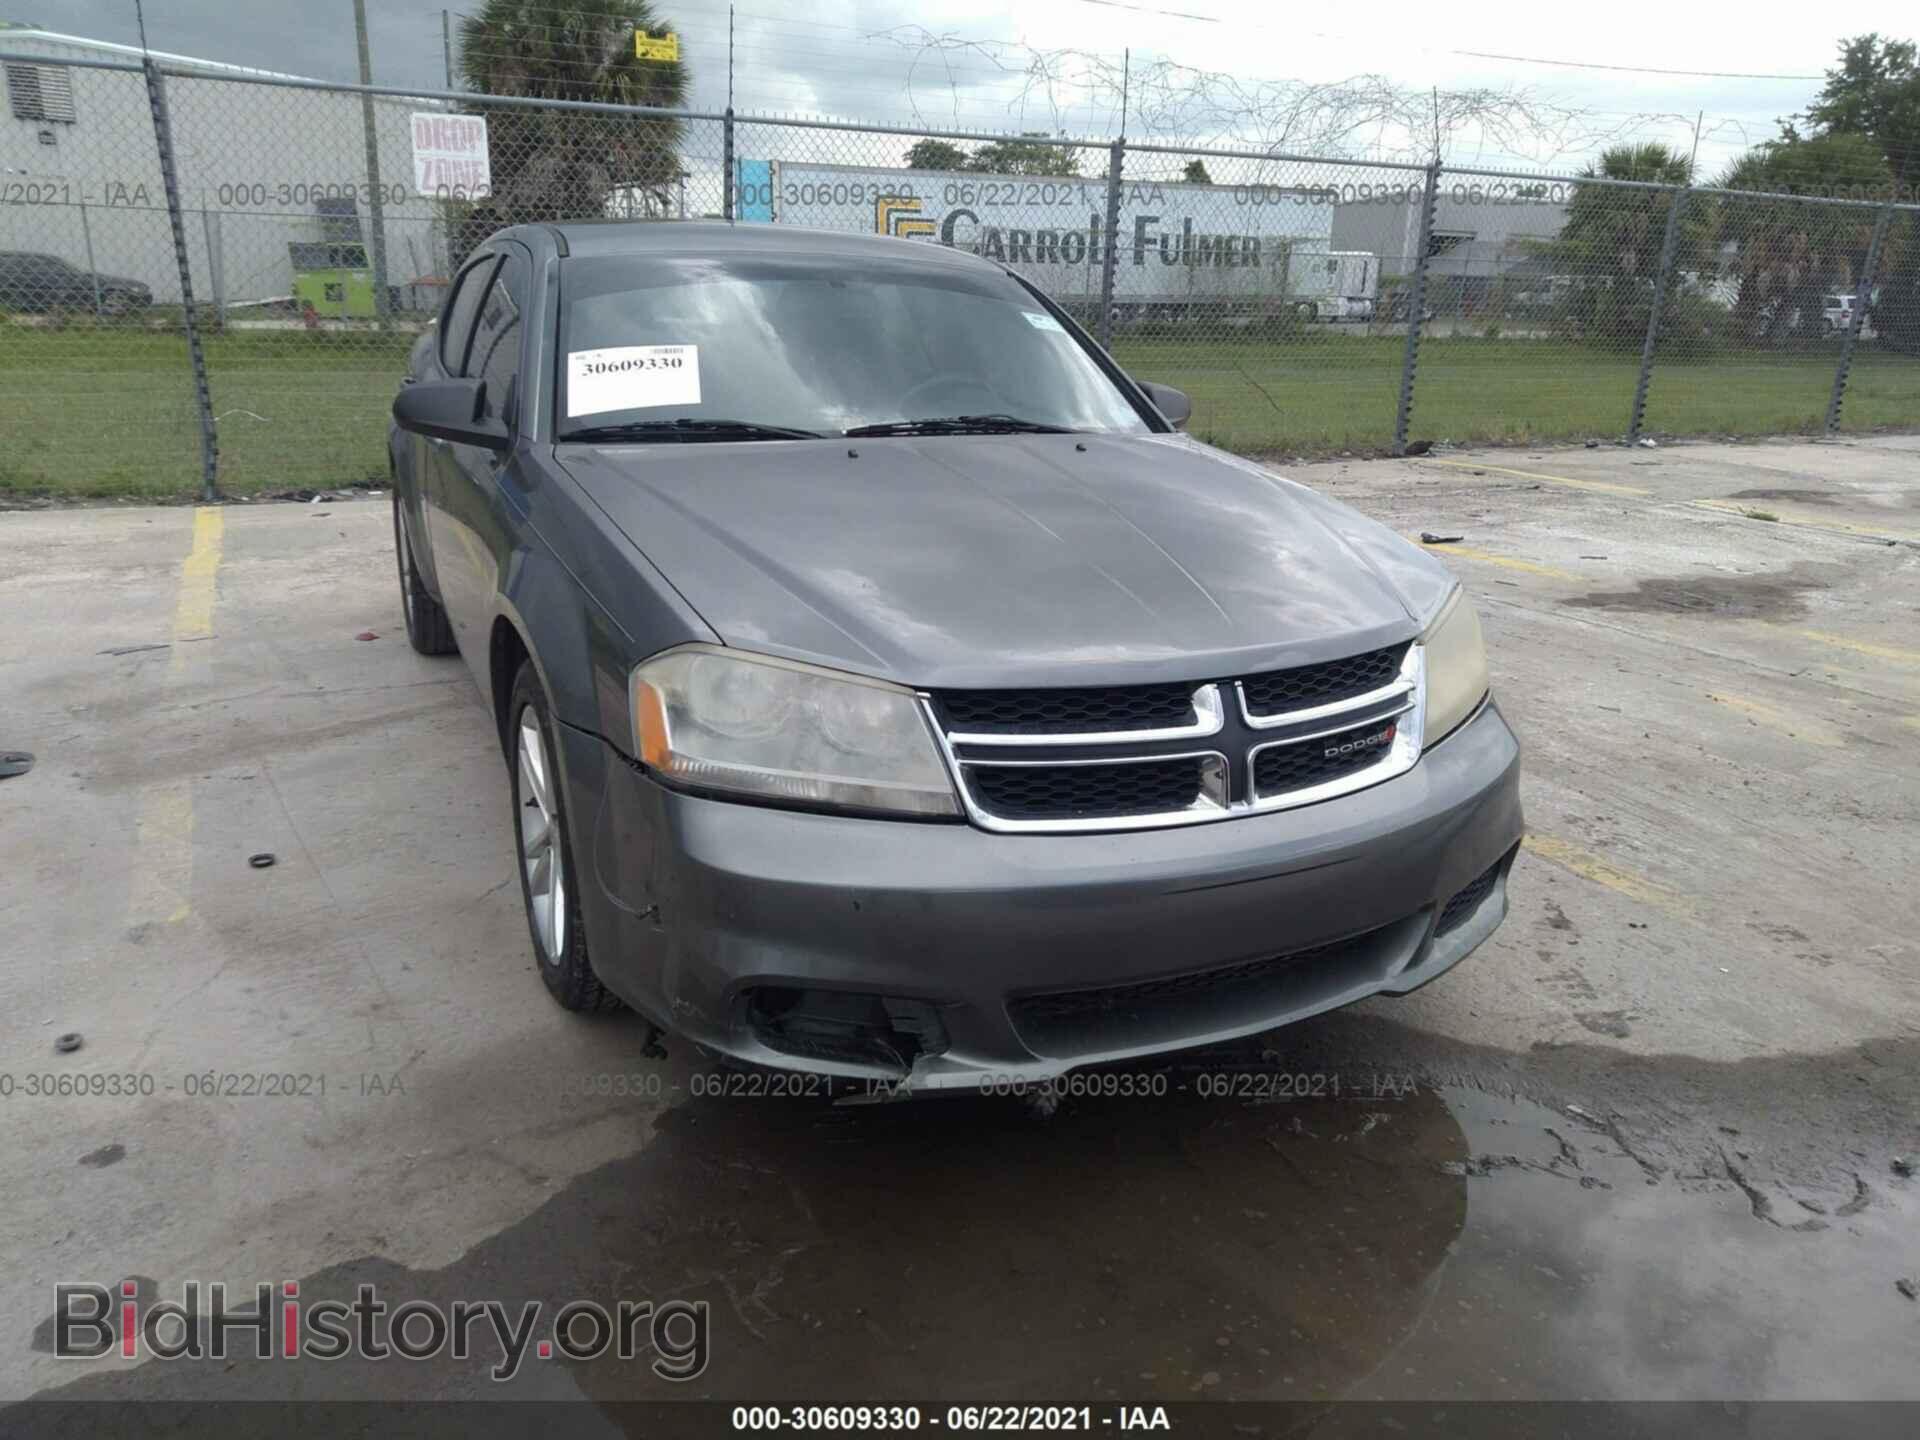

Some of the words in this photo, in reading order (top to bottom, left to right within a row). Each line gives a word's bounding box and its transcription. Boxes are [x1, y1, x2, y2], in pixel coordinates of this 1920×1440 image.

[415, 117, 481, 151] DROP
[419, 157, 485, 192] ZONE
[581, 357, 683, 377] 30609330
[1323, 734, 1388, 758] DODGE
